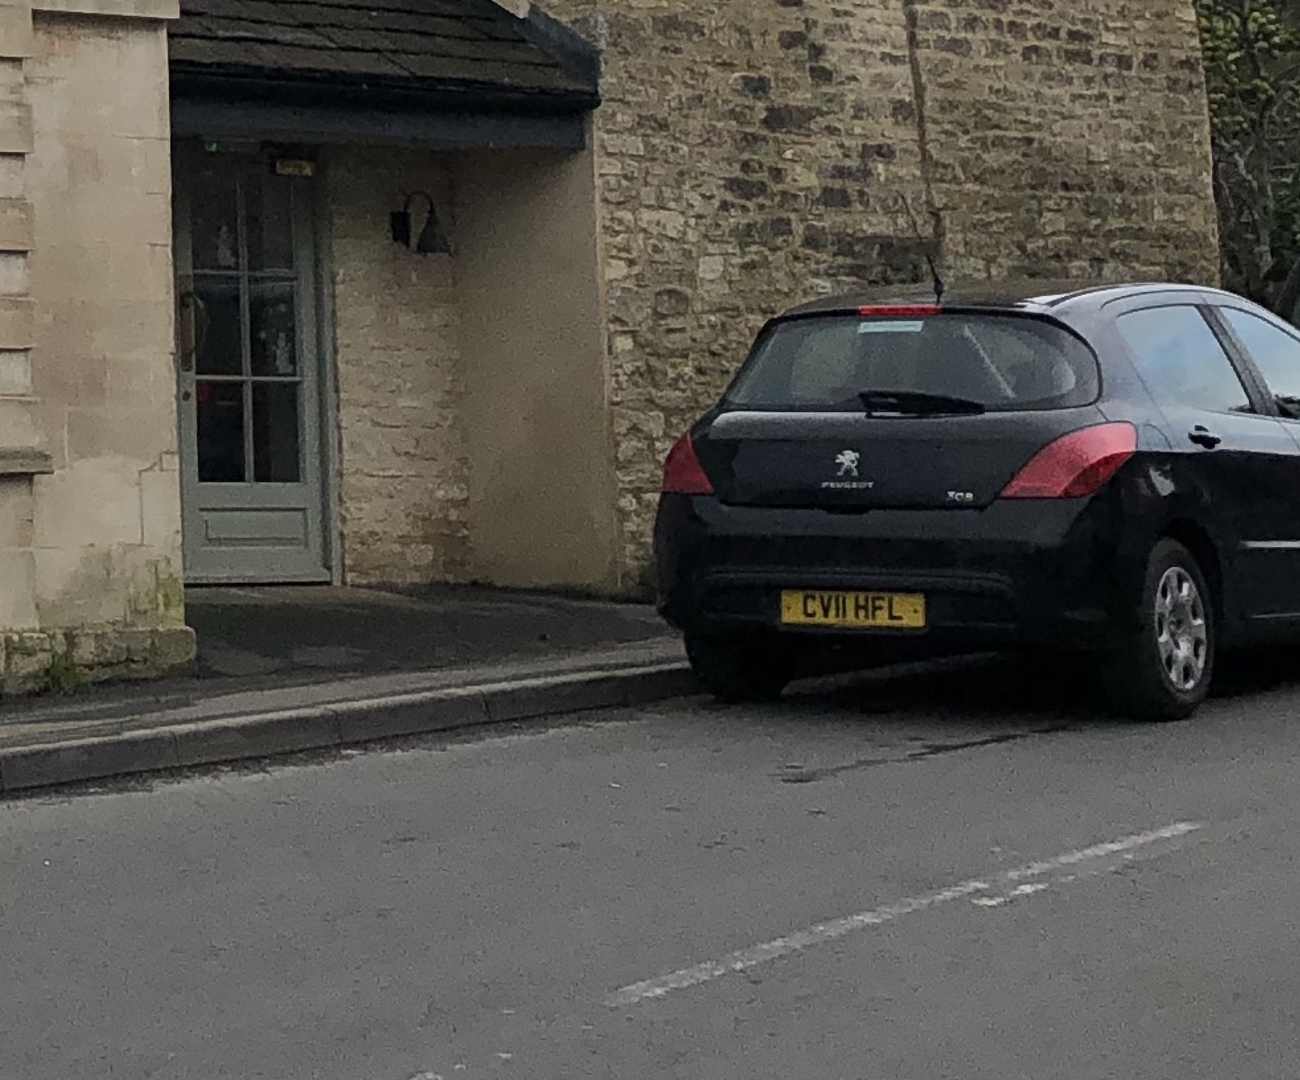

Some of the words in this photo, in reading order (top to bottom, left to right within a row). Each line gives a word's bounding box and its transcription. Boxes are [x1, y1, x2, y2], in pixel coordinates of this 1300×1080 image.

[821, 480, 875, 489] PEUGEOT
[801, 593, 848, 619] CV11
[853, 594, 904, 621] HFL
